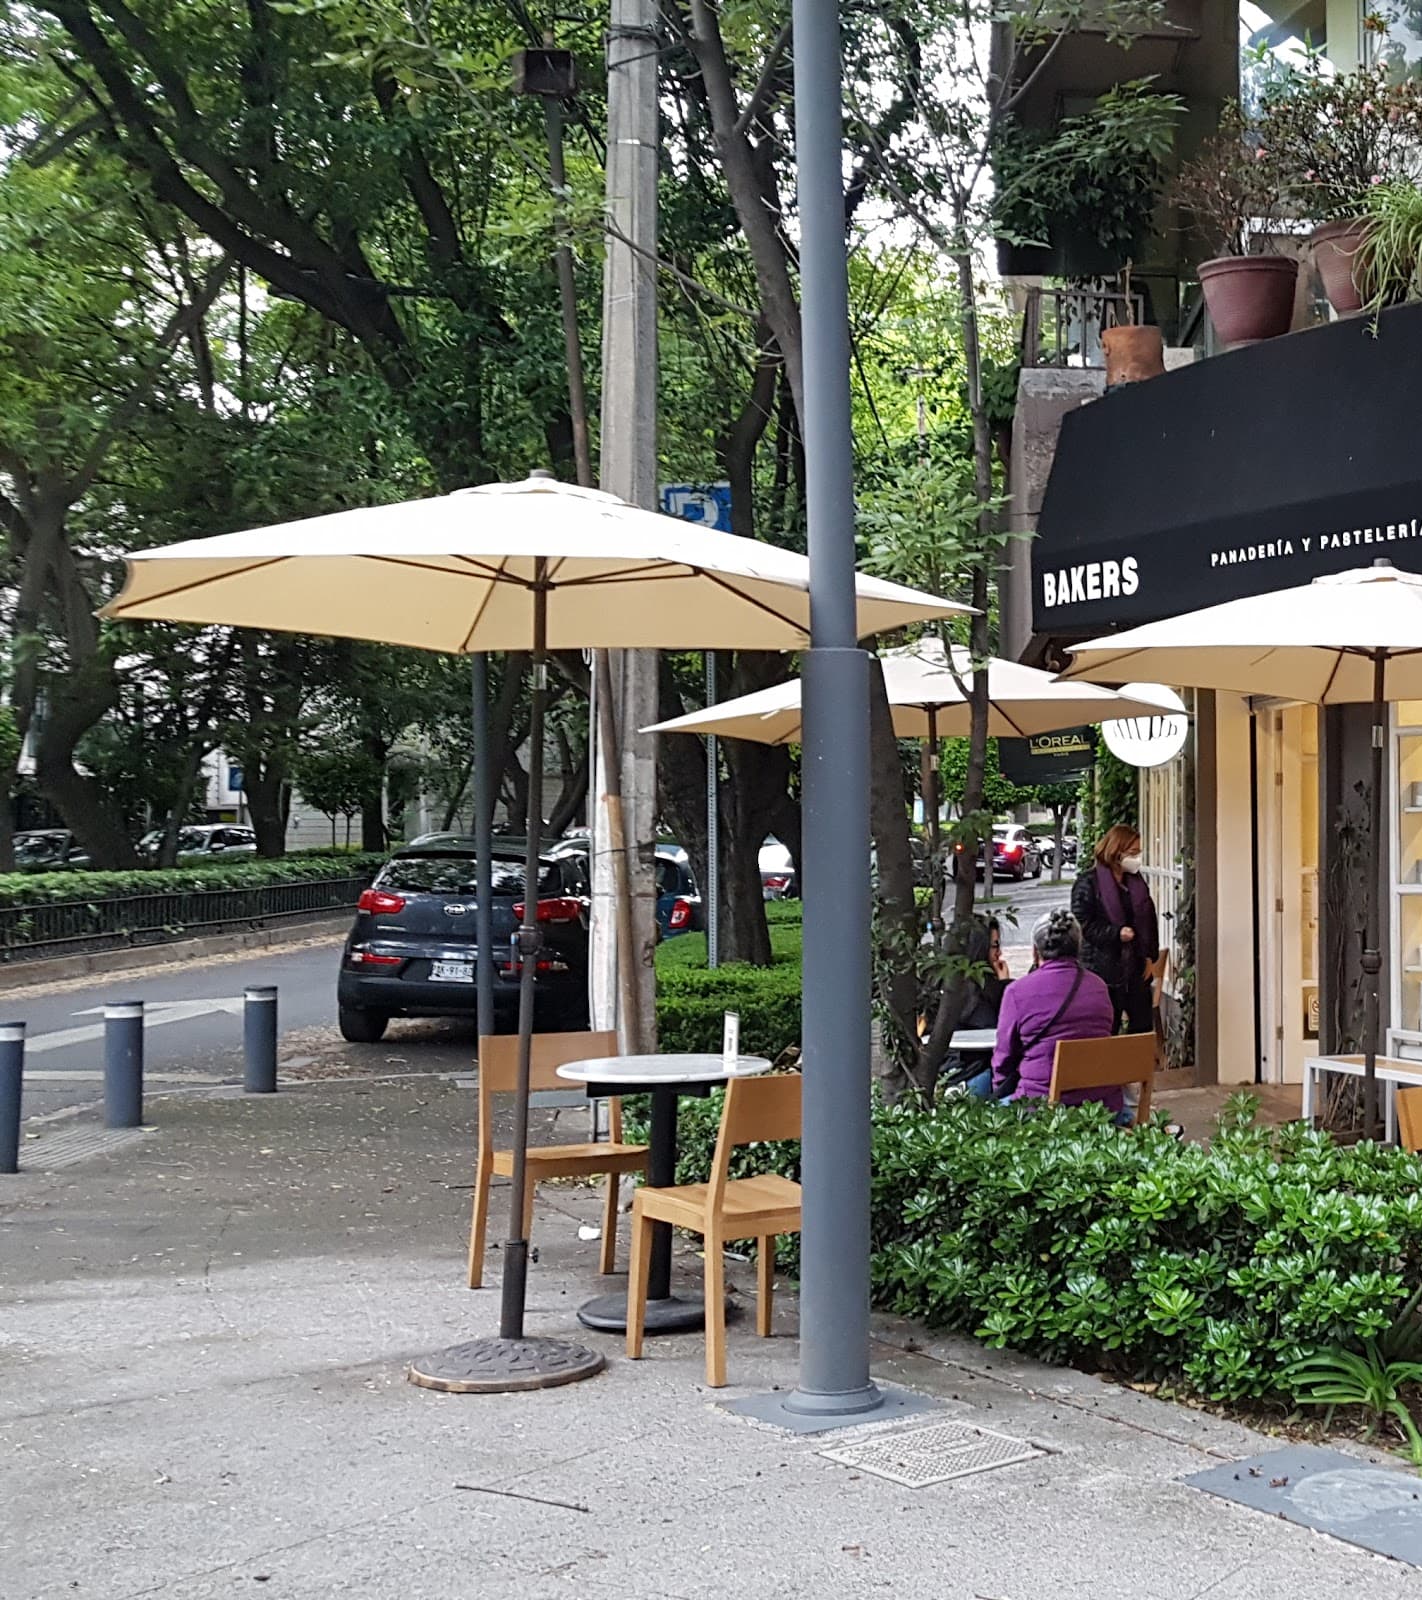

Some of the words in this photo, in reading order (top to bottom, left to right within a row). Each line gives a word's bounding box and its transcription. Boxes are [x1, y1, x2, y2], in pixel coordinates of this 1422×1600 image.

[1210, 539, 1294, 567] PANADERÍA
[1301, 537, 1312, 552] Y
[1043, 556, 1139, 608] BAKERS
